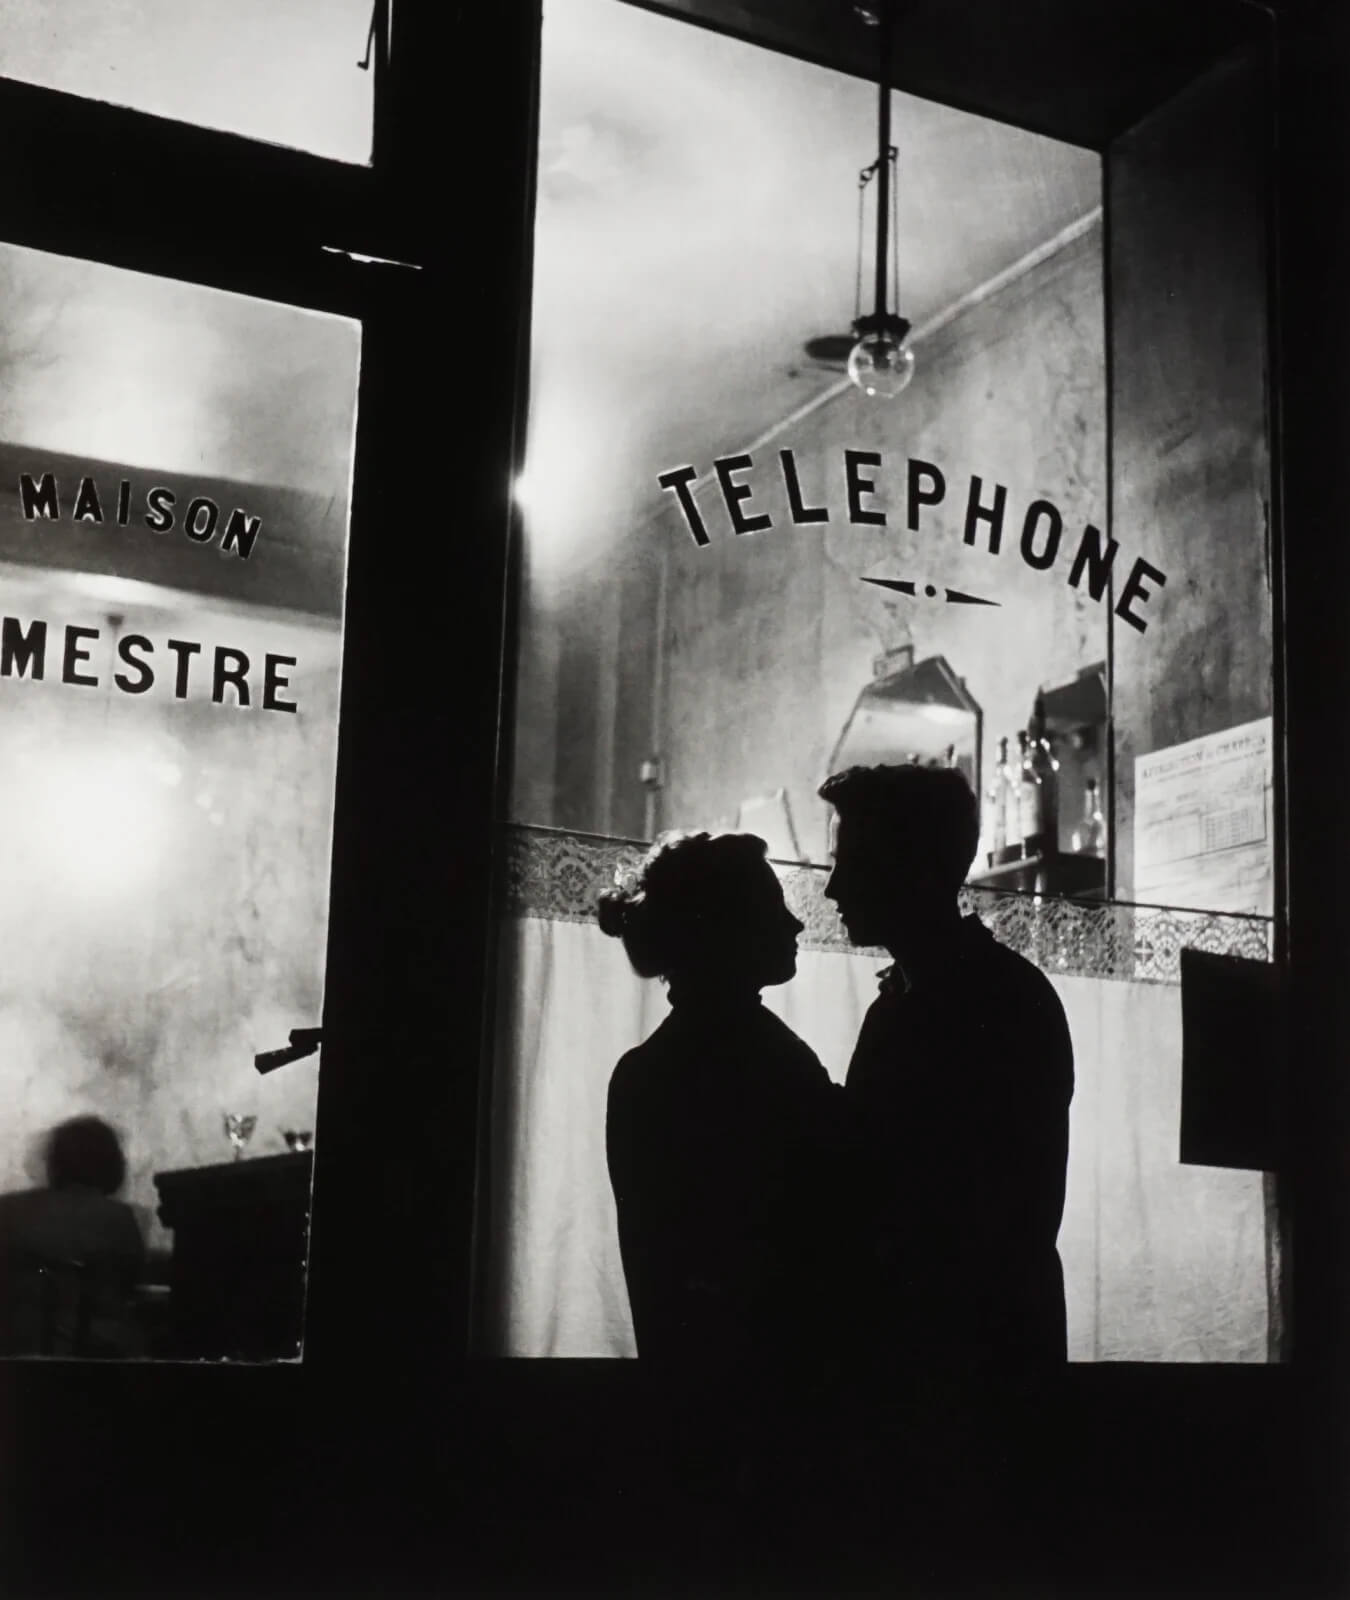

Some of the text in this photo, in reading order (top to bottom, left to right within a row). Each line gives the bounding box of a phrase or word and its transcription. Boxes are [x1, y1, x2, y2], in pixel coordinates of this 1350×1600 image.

[20, 473, 261, 559] MAISON
[658, 450, 1166, 633] TELEPHONE
[0, 617, 297, 713] MESTRE
